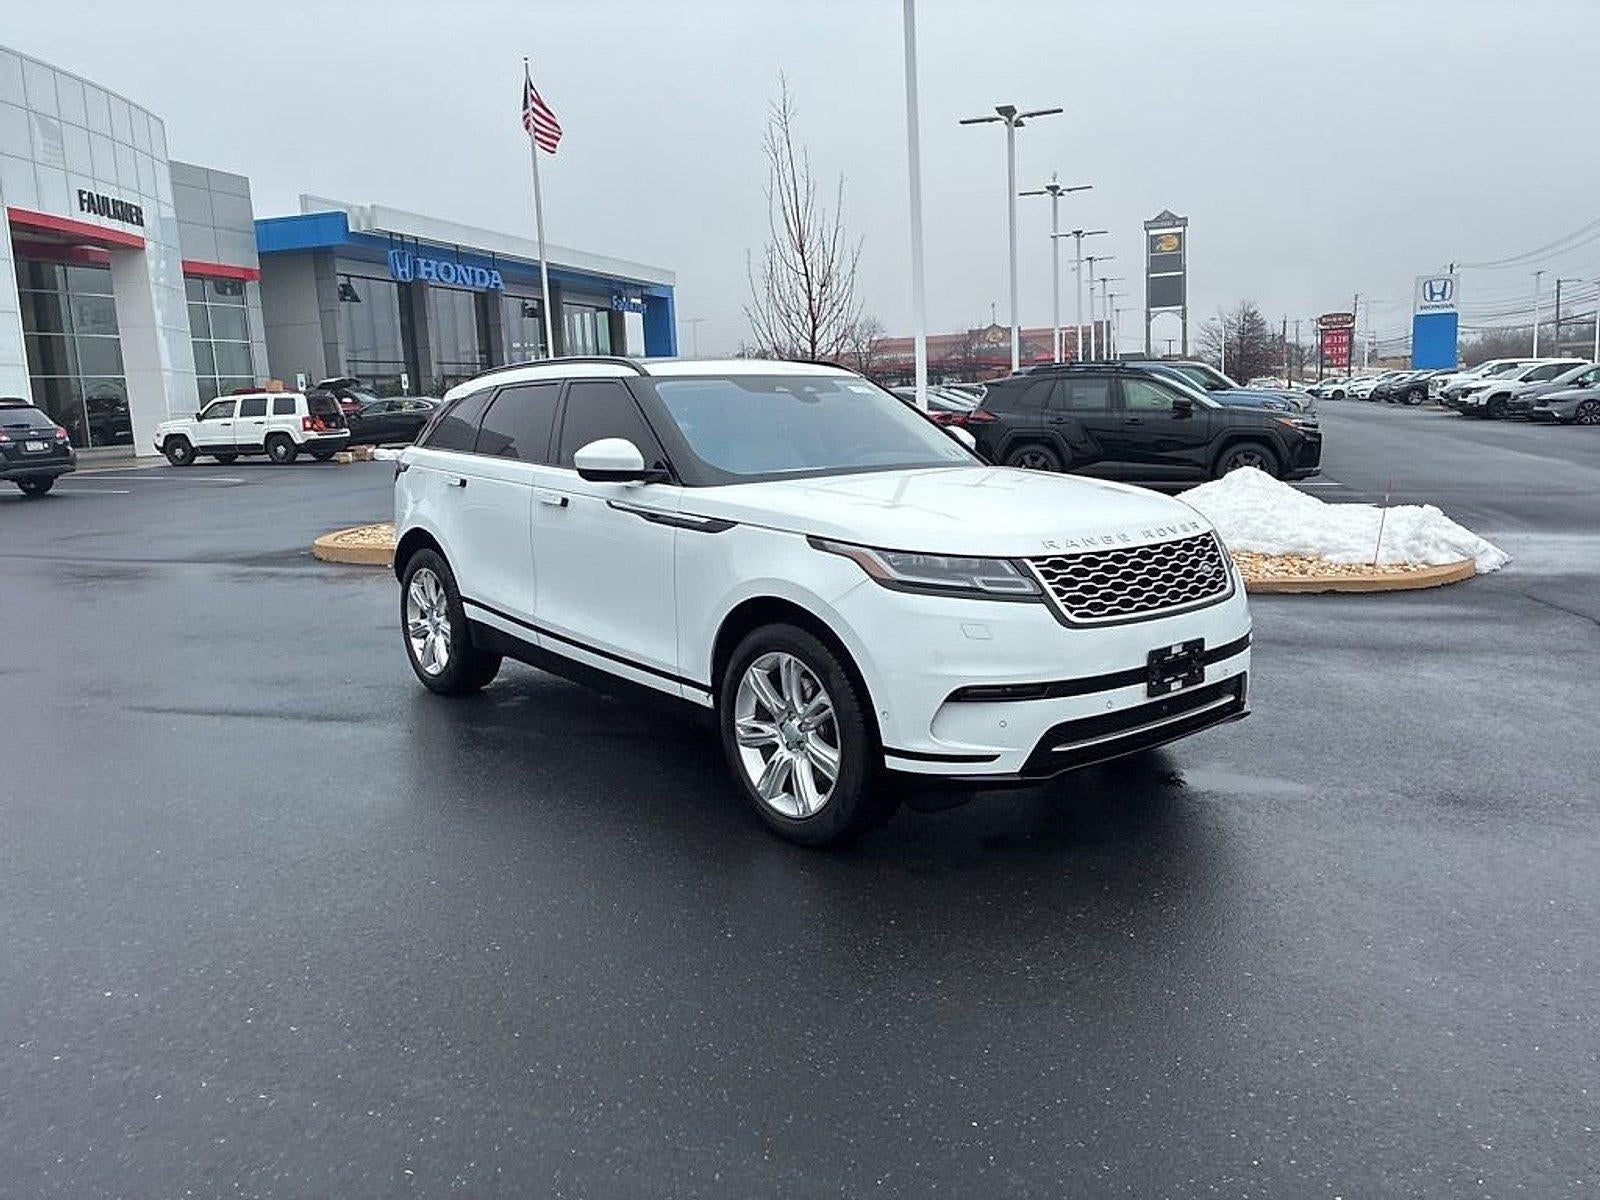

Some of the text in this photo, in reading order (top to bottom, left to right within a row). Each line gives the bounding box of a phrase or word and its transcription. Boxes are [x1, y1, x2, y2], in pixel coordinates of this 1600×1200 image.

[78, 189, 145, 227] FAULKNER
[416, 258, 504, 290] HONDA
[1041, 522, 1200, 550] RANGE ROVER
